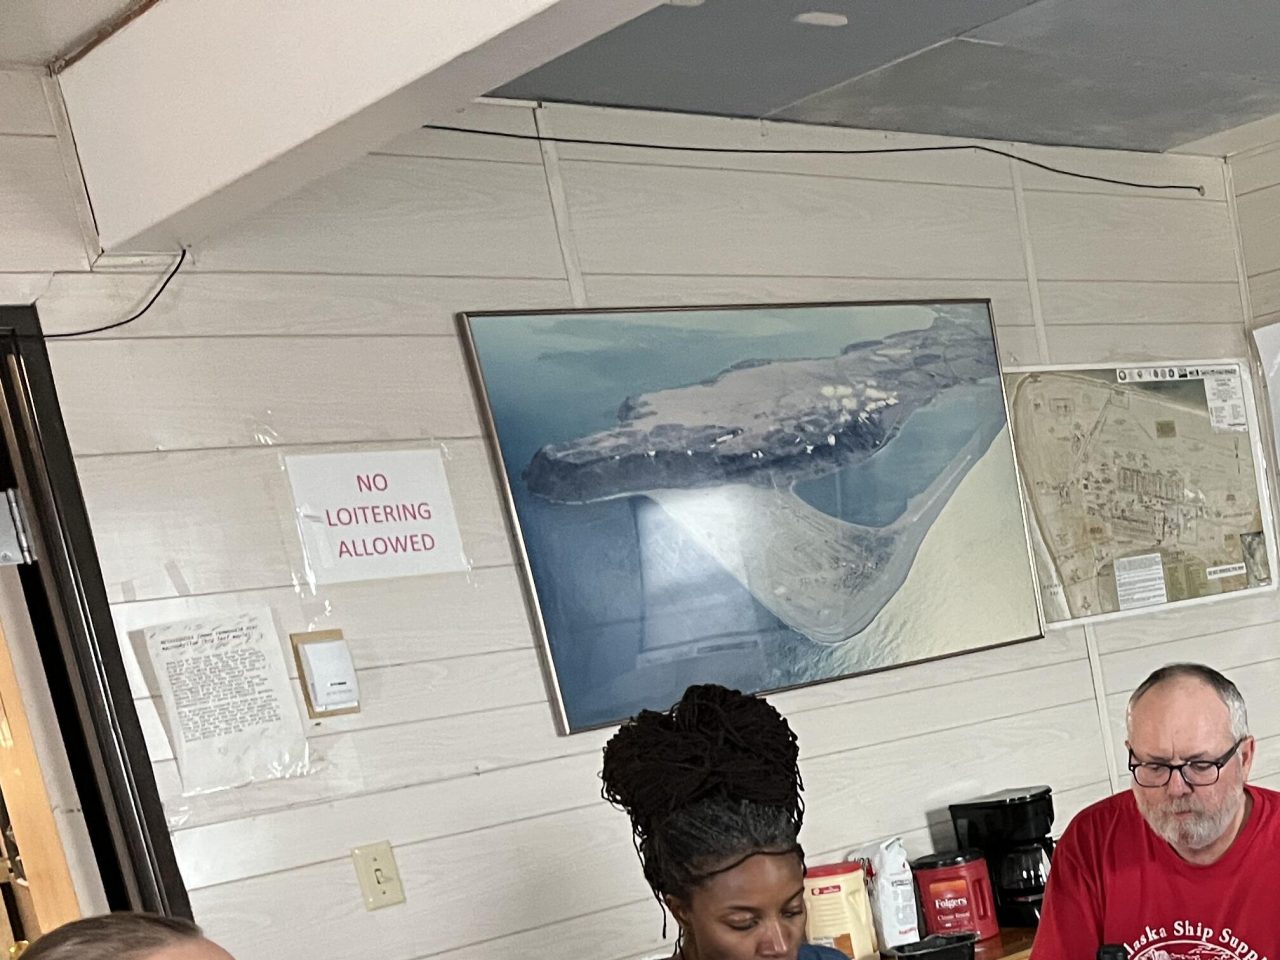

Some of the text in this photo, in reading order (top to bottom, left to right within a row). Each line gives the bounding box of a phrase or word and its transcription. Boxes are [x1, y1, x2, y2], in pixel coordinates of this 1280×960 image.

[356, 473, 388, 492] NO
[326, 502, 432, 527] LOITERING
[339, 533, 435, 558] ALLOWED
[935, 897, 968, 909] Folgers
[1123, 926, 1167, 957] laska
[1173, 920, 1214, 942] Ship
